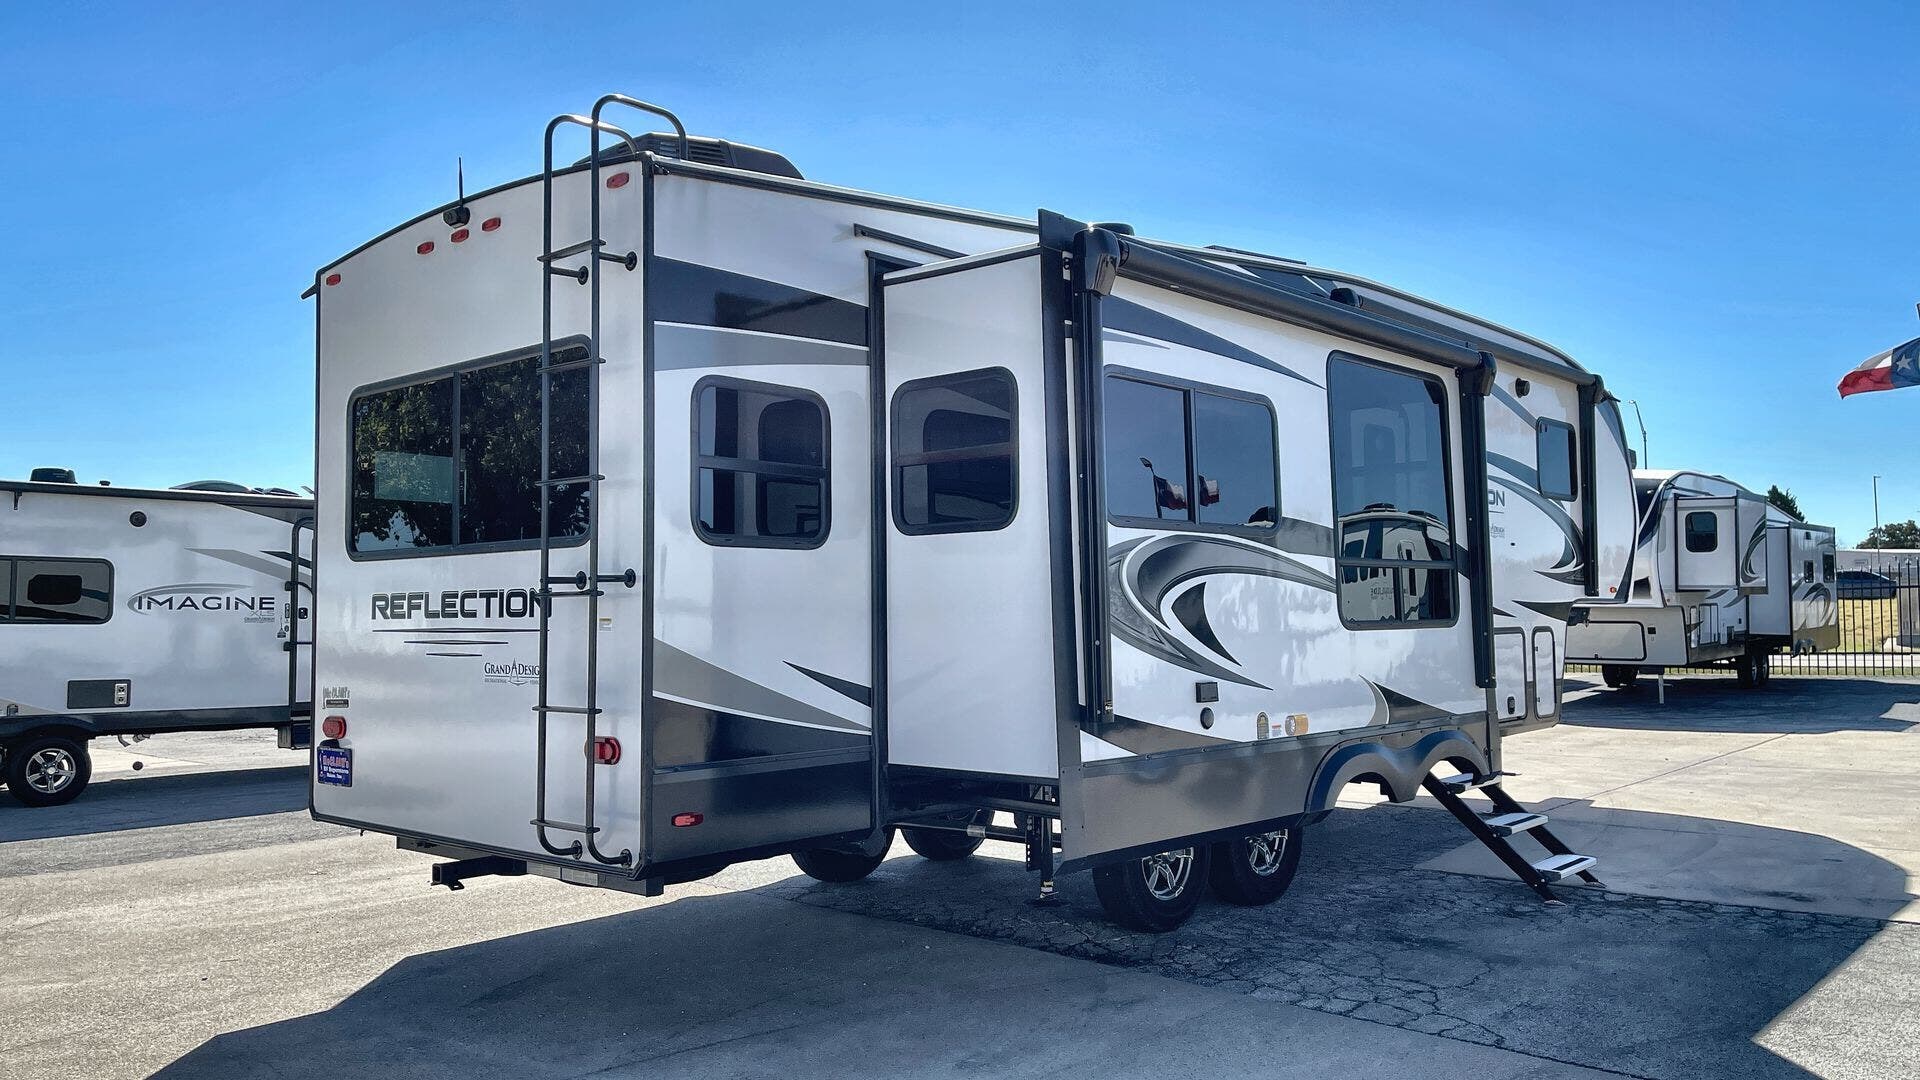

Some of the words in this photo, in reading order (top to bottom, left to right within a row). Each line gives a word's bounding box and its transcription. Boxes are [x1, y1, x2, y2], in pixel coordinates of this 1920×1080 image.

[137, 595, 275, 610] IMAGINE
[371, 588, 552, 620] REFLECTION
[484, 662, 511, 675] GRAND
[518, 663, 540, 676] DESIG
